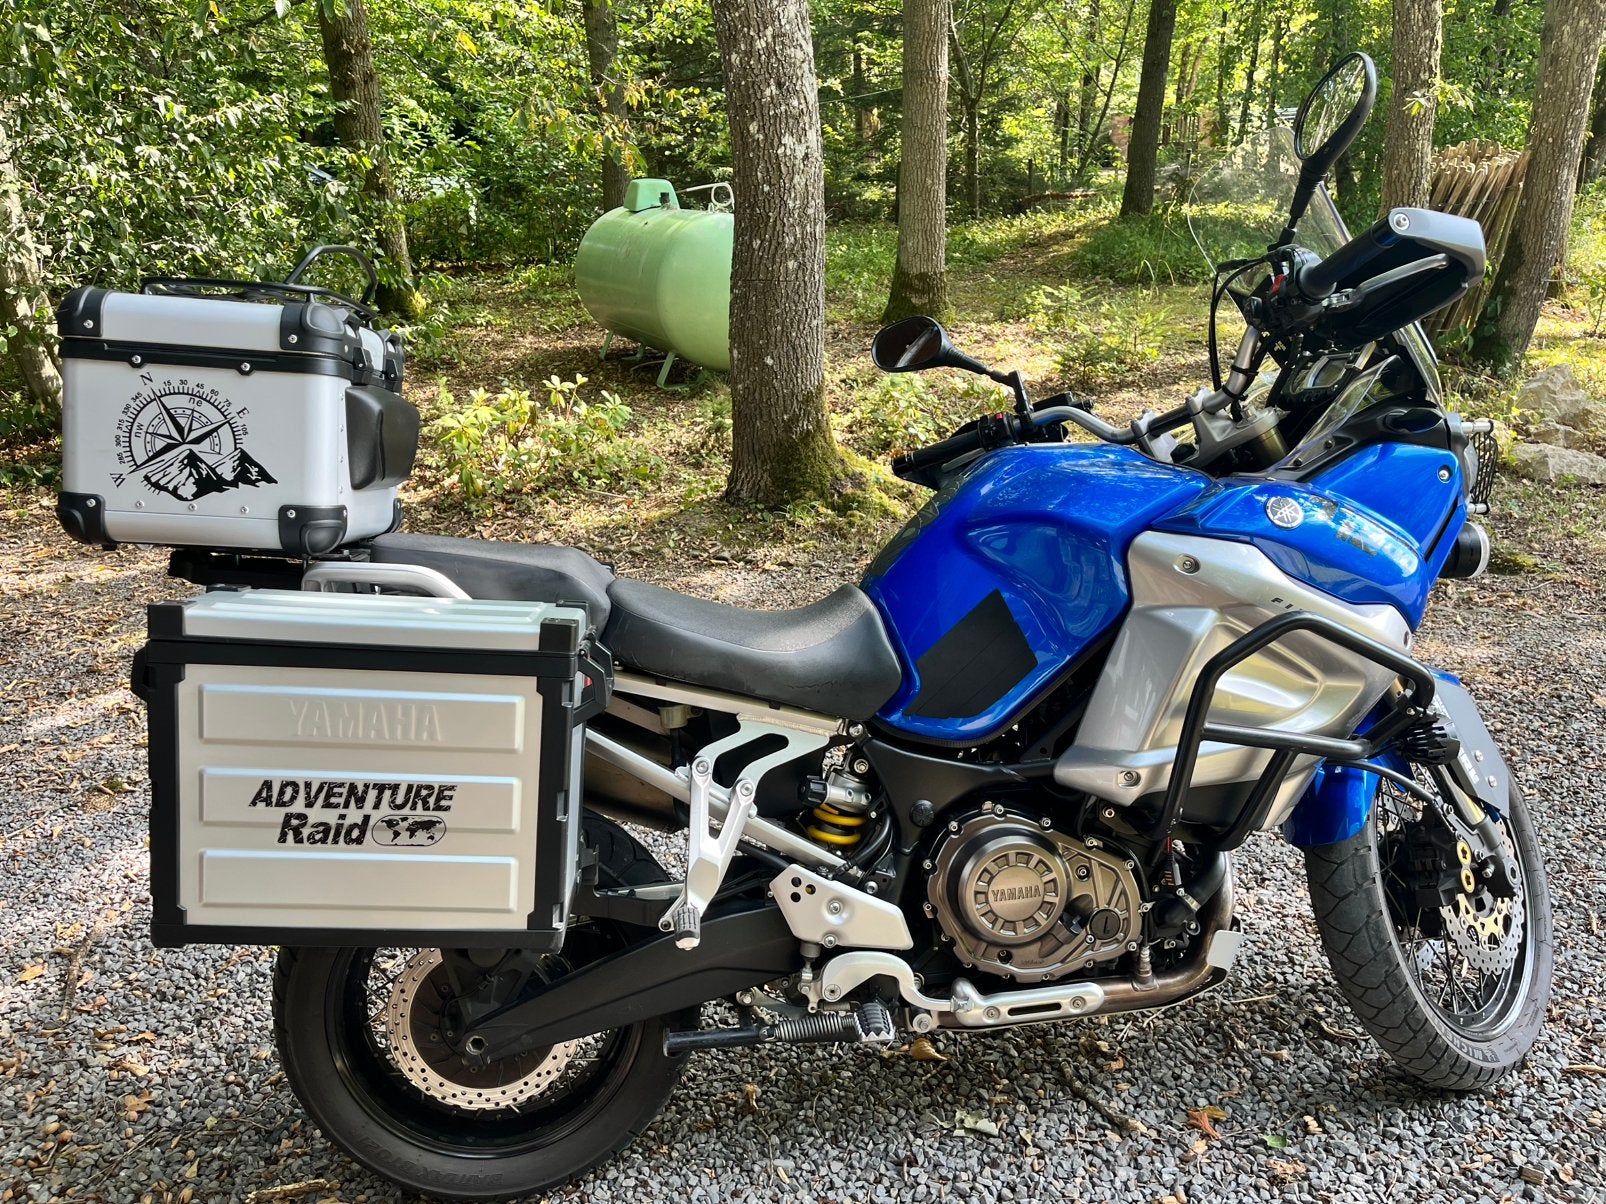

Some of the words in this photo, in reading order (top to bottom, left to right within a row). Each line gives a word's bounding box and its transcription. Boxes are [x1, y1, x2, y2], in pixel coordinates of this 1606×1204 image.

[140, 372, 153, 385] N
[131, 392, 143, 403] 345
[188, 397, 203, 406] ne
[223, 398, 232, 408] 75
[122, 404, 132, 415] 330
[236, 407, 250, 418] E
[117, 419, 125, 431] 315
[240, 424, 249, 436] 105
[117, 452, 126, 465] 285
[109, 473, 126, 488] W
[1271, 597, 1302, 610] FI
[289, 699, 443, 742] YAMAHA
[248, 779, 458, 812] ADVENTURE
[277, 812, 371, 846] Raid
[991, 885, 1041, 902] YAMAHA
